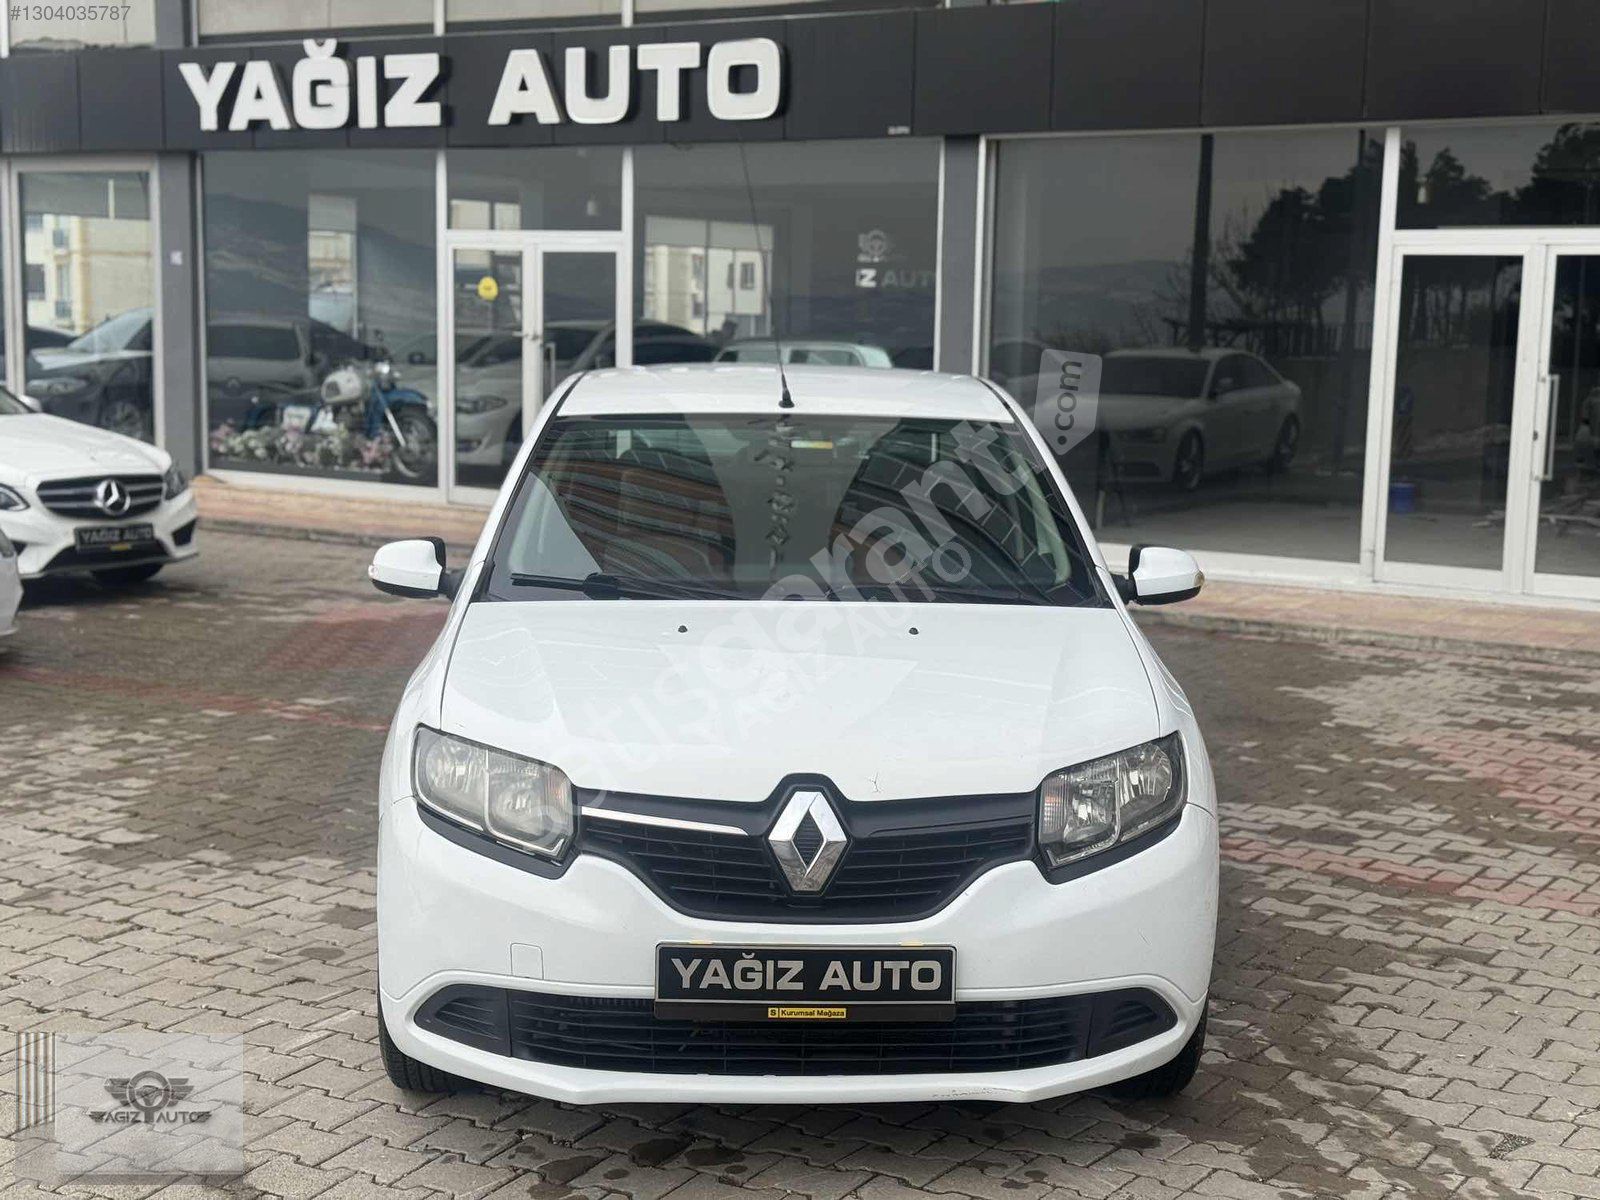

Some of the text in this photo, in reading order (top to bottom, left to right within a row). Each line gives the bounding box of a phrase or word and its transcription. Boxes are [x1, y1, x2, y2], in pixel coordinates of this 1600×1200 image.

[178, 38, 780, 131] YAĞIZ AUTO
[671, 952, 942, 991] YAĞIZ AUTO
